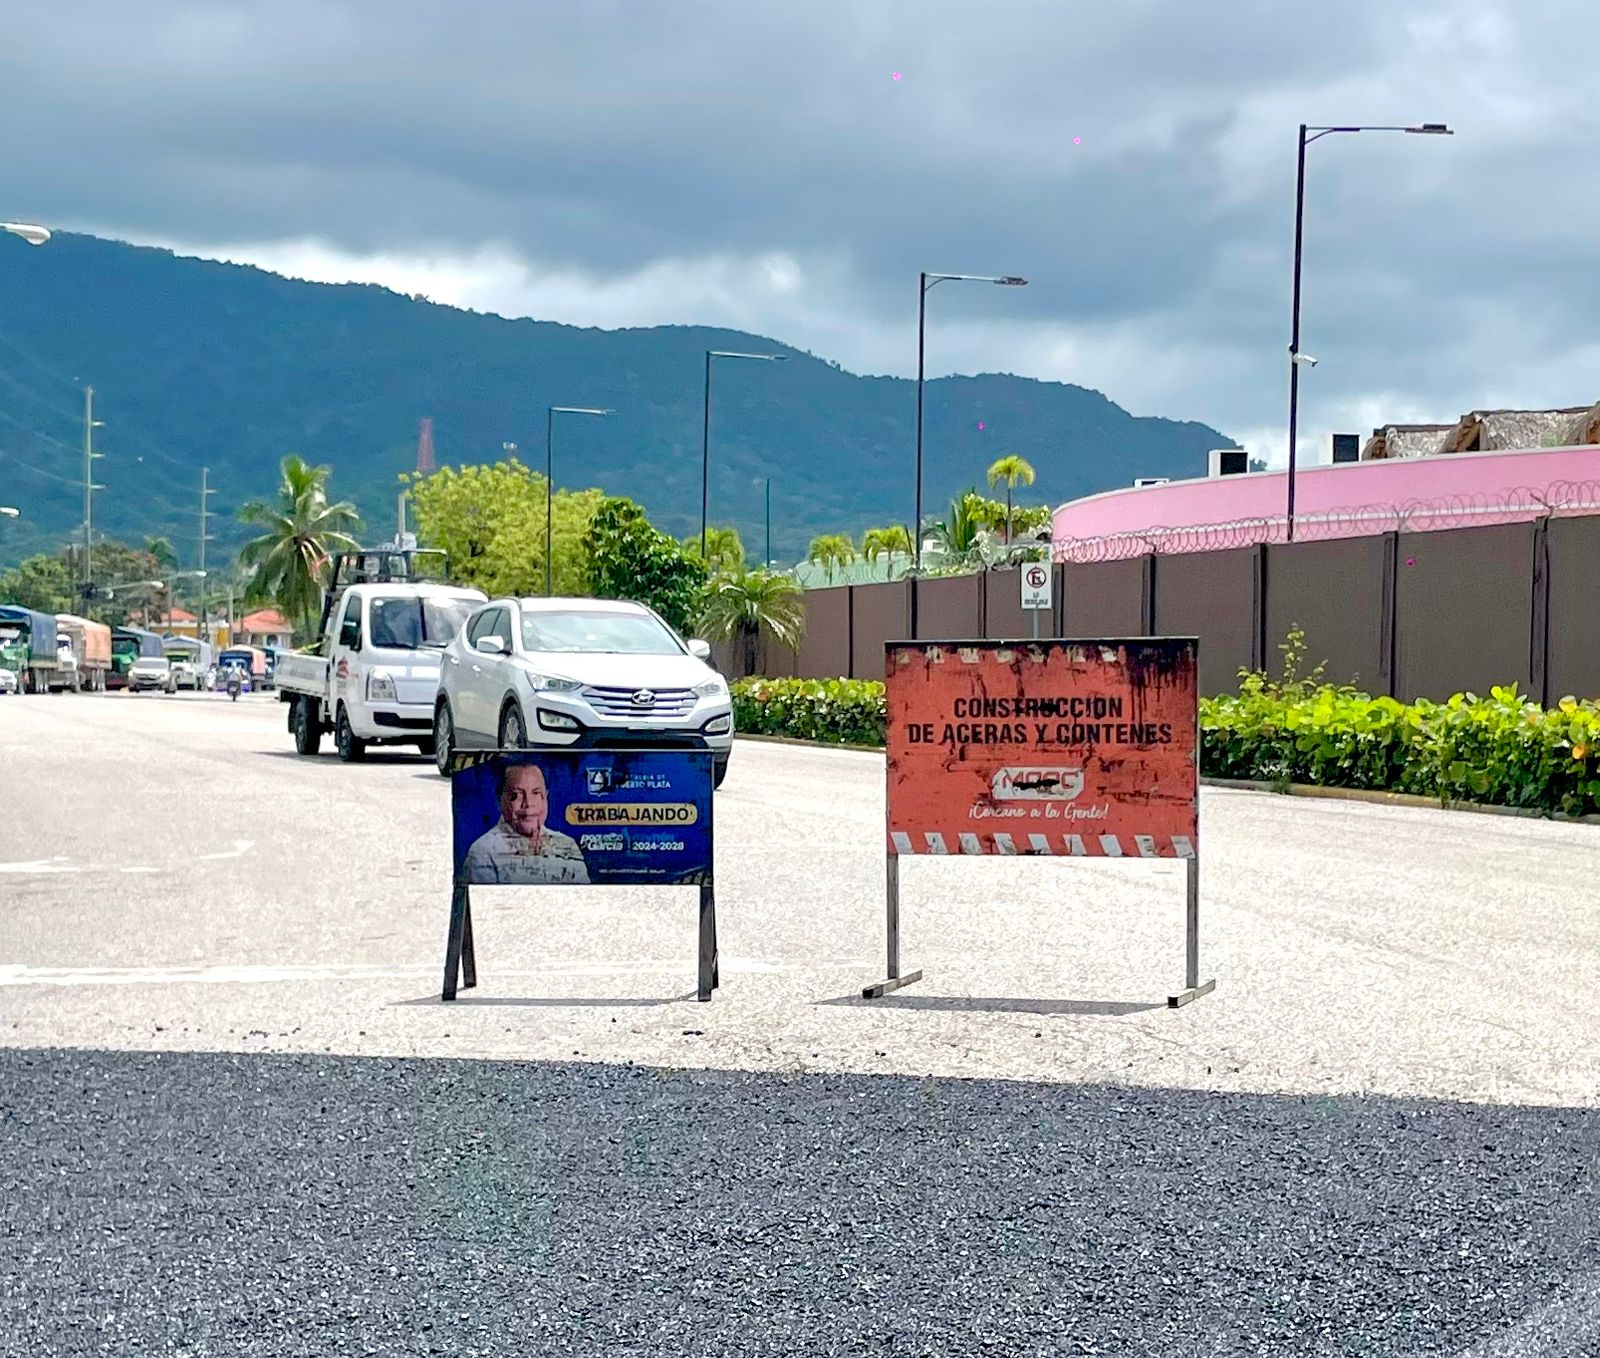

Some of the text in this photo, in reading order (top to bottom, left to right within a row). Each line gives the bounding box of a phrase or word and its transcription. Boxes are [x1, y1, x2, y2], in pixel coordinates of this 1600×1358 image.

[909, 722, 1173, 744] DE ACERAS Y CONTENES
[647, 780, 672, 788] PLATA
[574, 807, 689, 821] TRABAJANDO
[1030, 807, 1041, 818] a
[1045, 802, 1060, 818] la
[632, 841, 685, 851] 2024-2028
